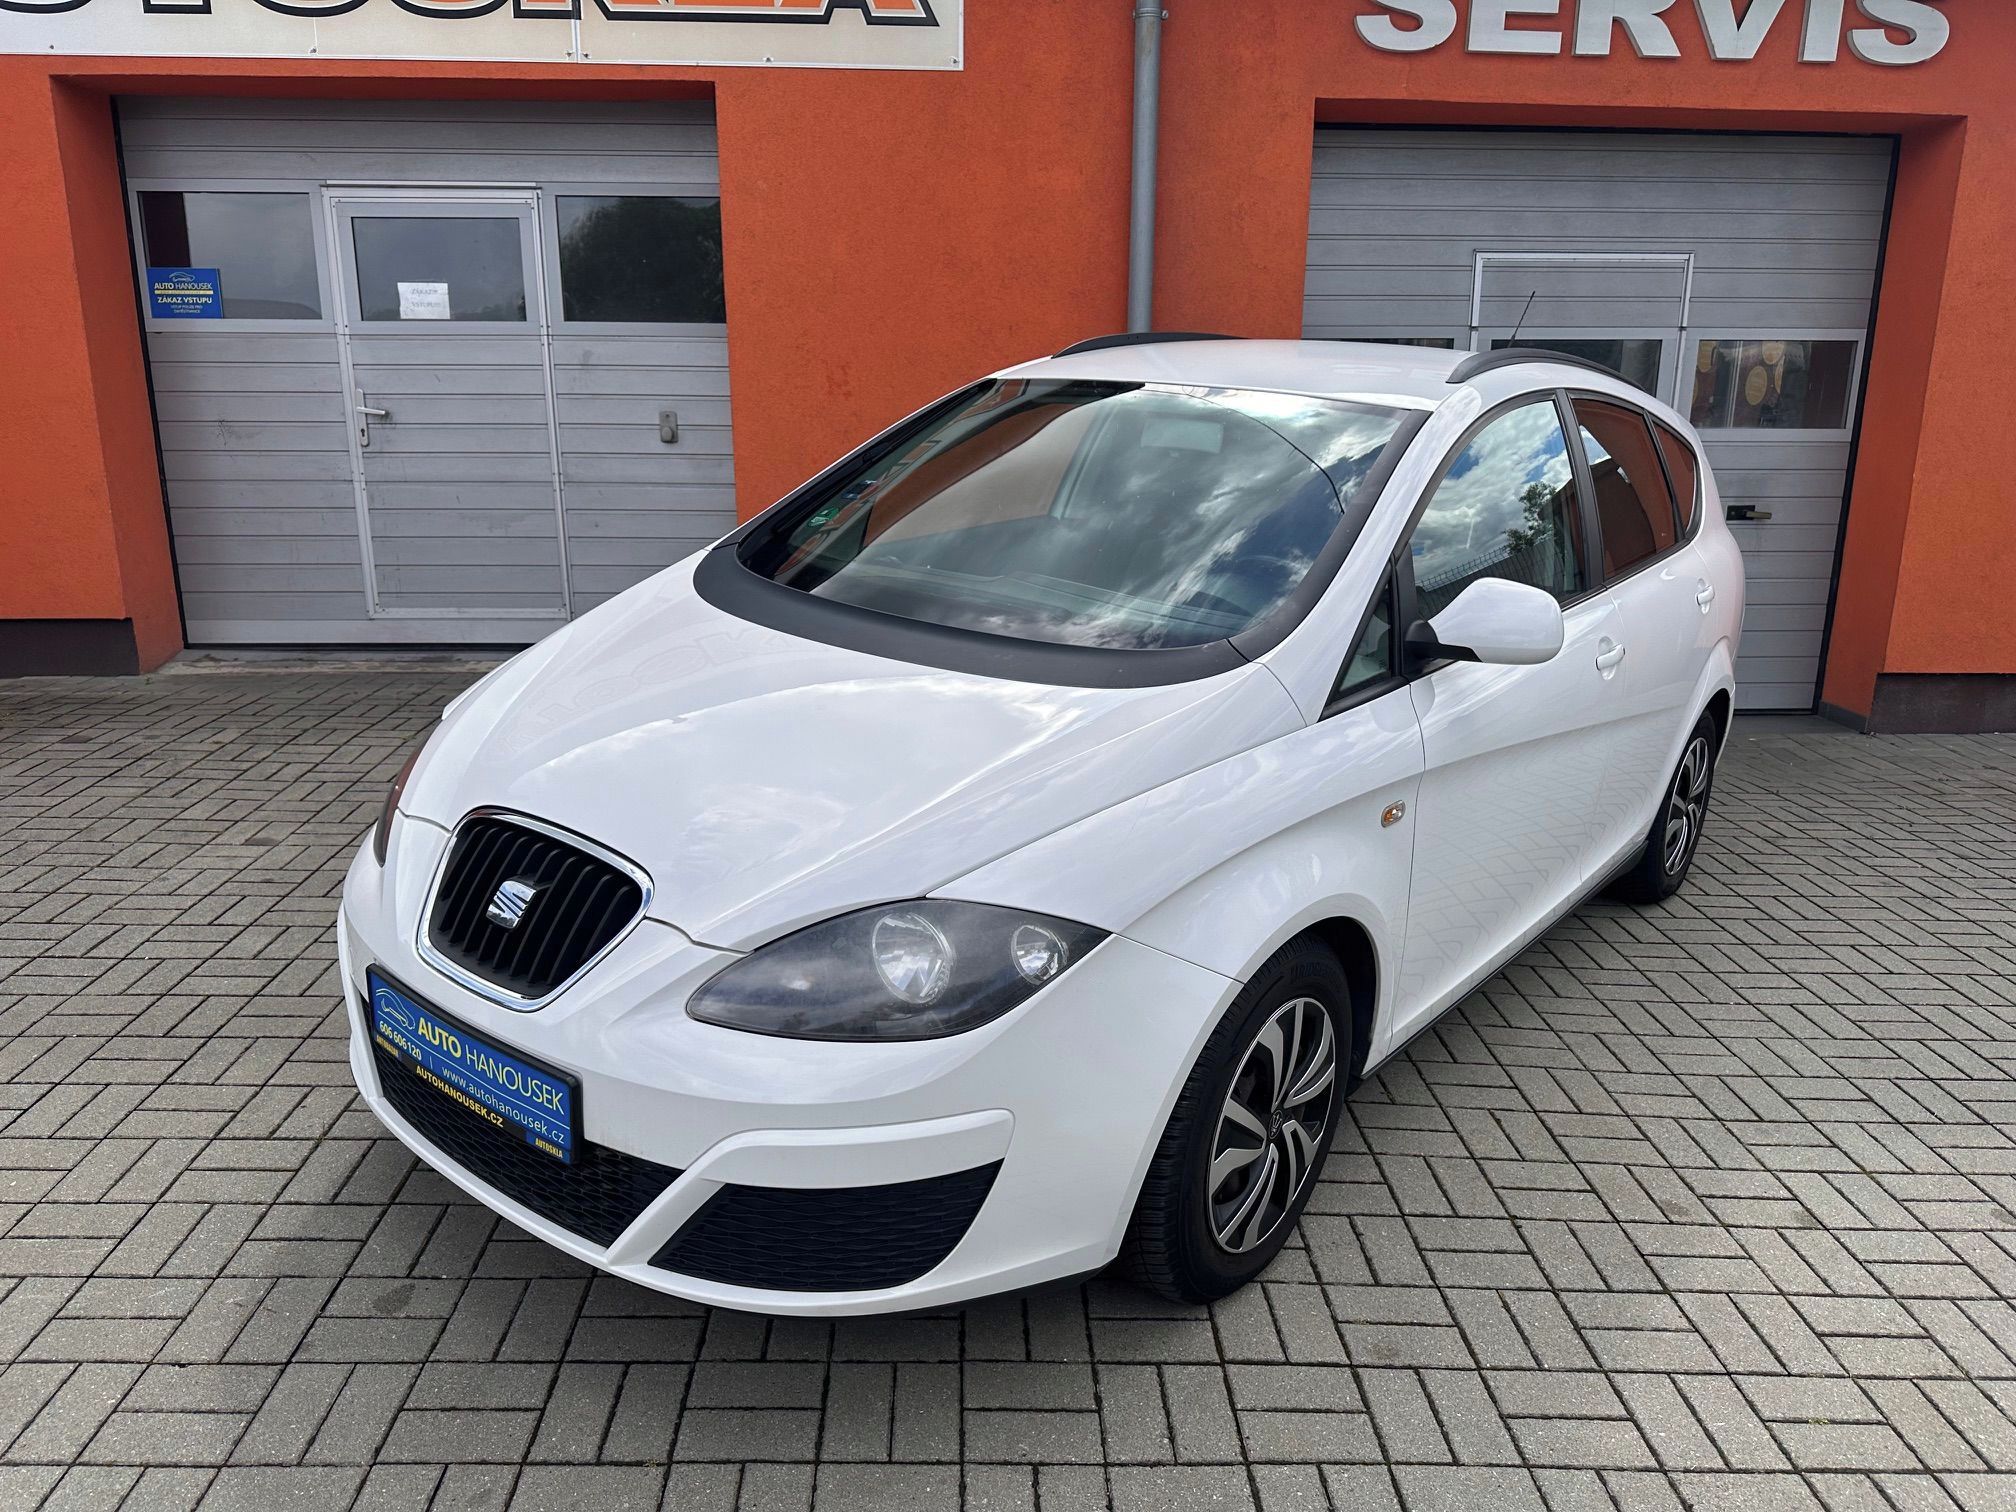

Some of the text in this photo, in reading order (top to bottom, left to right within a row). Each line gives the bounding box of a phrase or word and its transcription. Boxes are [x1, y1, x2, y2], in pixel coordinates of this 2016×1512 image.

[1355, 0, 1951, 66] SERVIS
[154, 282, 212, 290] AUTO HANOUSEK
[157, 295, 182, 304] ZÁKAZ
[417, 1017, 564, 1115] AUTO HANOUSEK
[442, 1066, 565, 1145] www.autohanousek.cz
